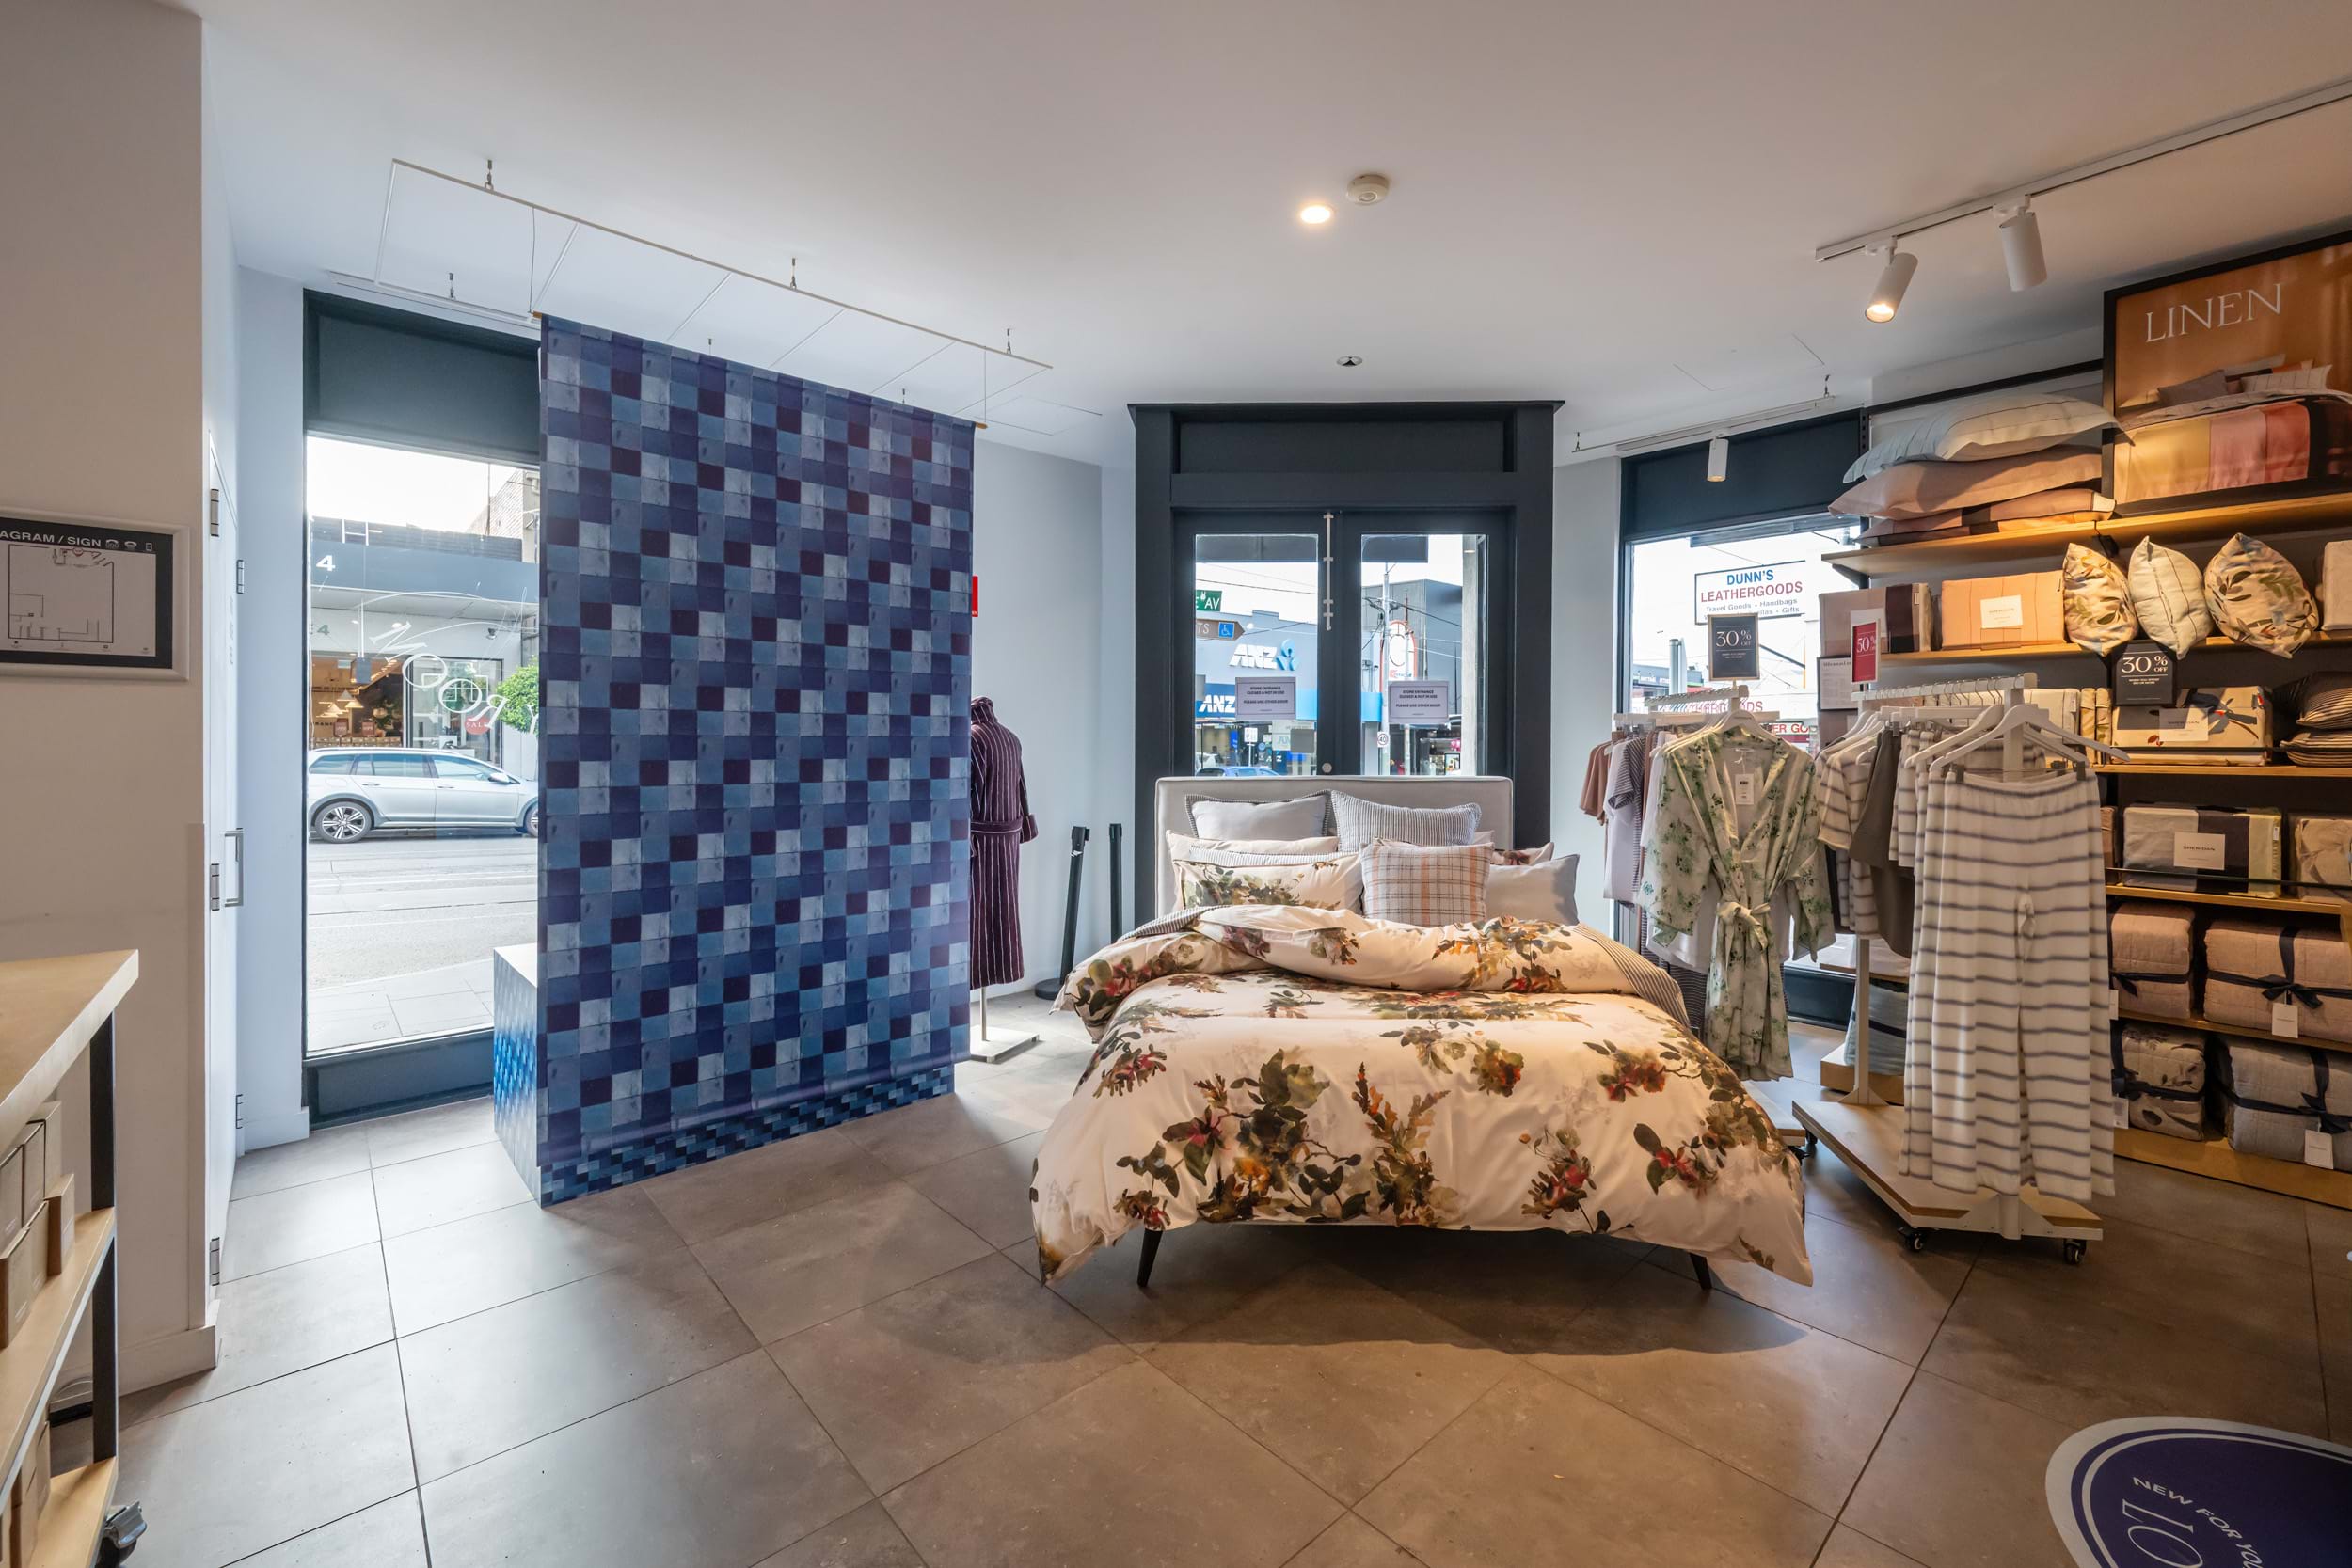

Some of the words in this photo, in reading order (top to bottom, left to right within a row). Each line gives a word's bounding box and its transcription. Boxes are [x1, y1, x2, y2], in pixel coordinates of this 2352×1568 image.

[2145, 283, 2280, 342] LINEN
[67, 536, 102, 547] SIGN
[316, 554, 336, 572] 4
[1726, 569, 1774, 586] DUNN'S
[1700, 580, 1803, 603] LEATHERGOODS
[1204, 597, 1220, 610] AV
[1706, 605, 1726, 613] Travel
[1727, 602, 1752, 611] Goods
[1759, 597, 1798, 608] Handbags
[1781, 606, 1800, 614] Gifts
[1229, 644, 1278, 669] ANZ
[1198, 695, 1236, 713] ANZ
[2133, 1476, 2193, 1505] NEW
[2196, 1508, 2243, 1539] FOR
